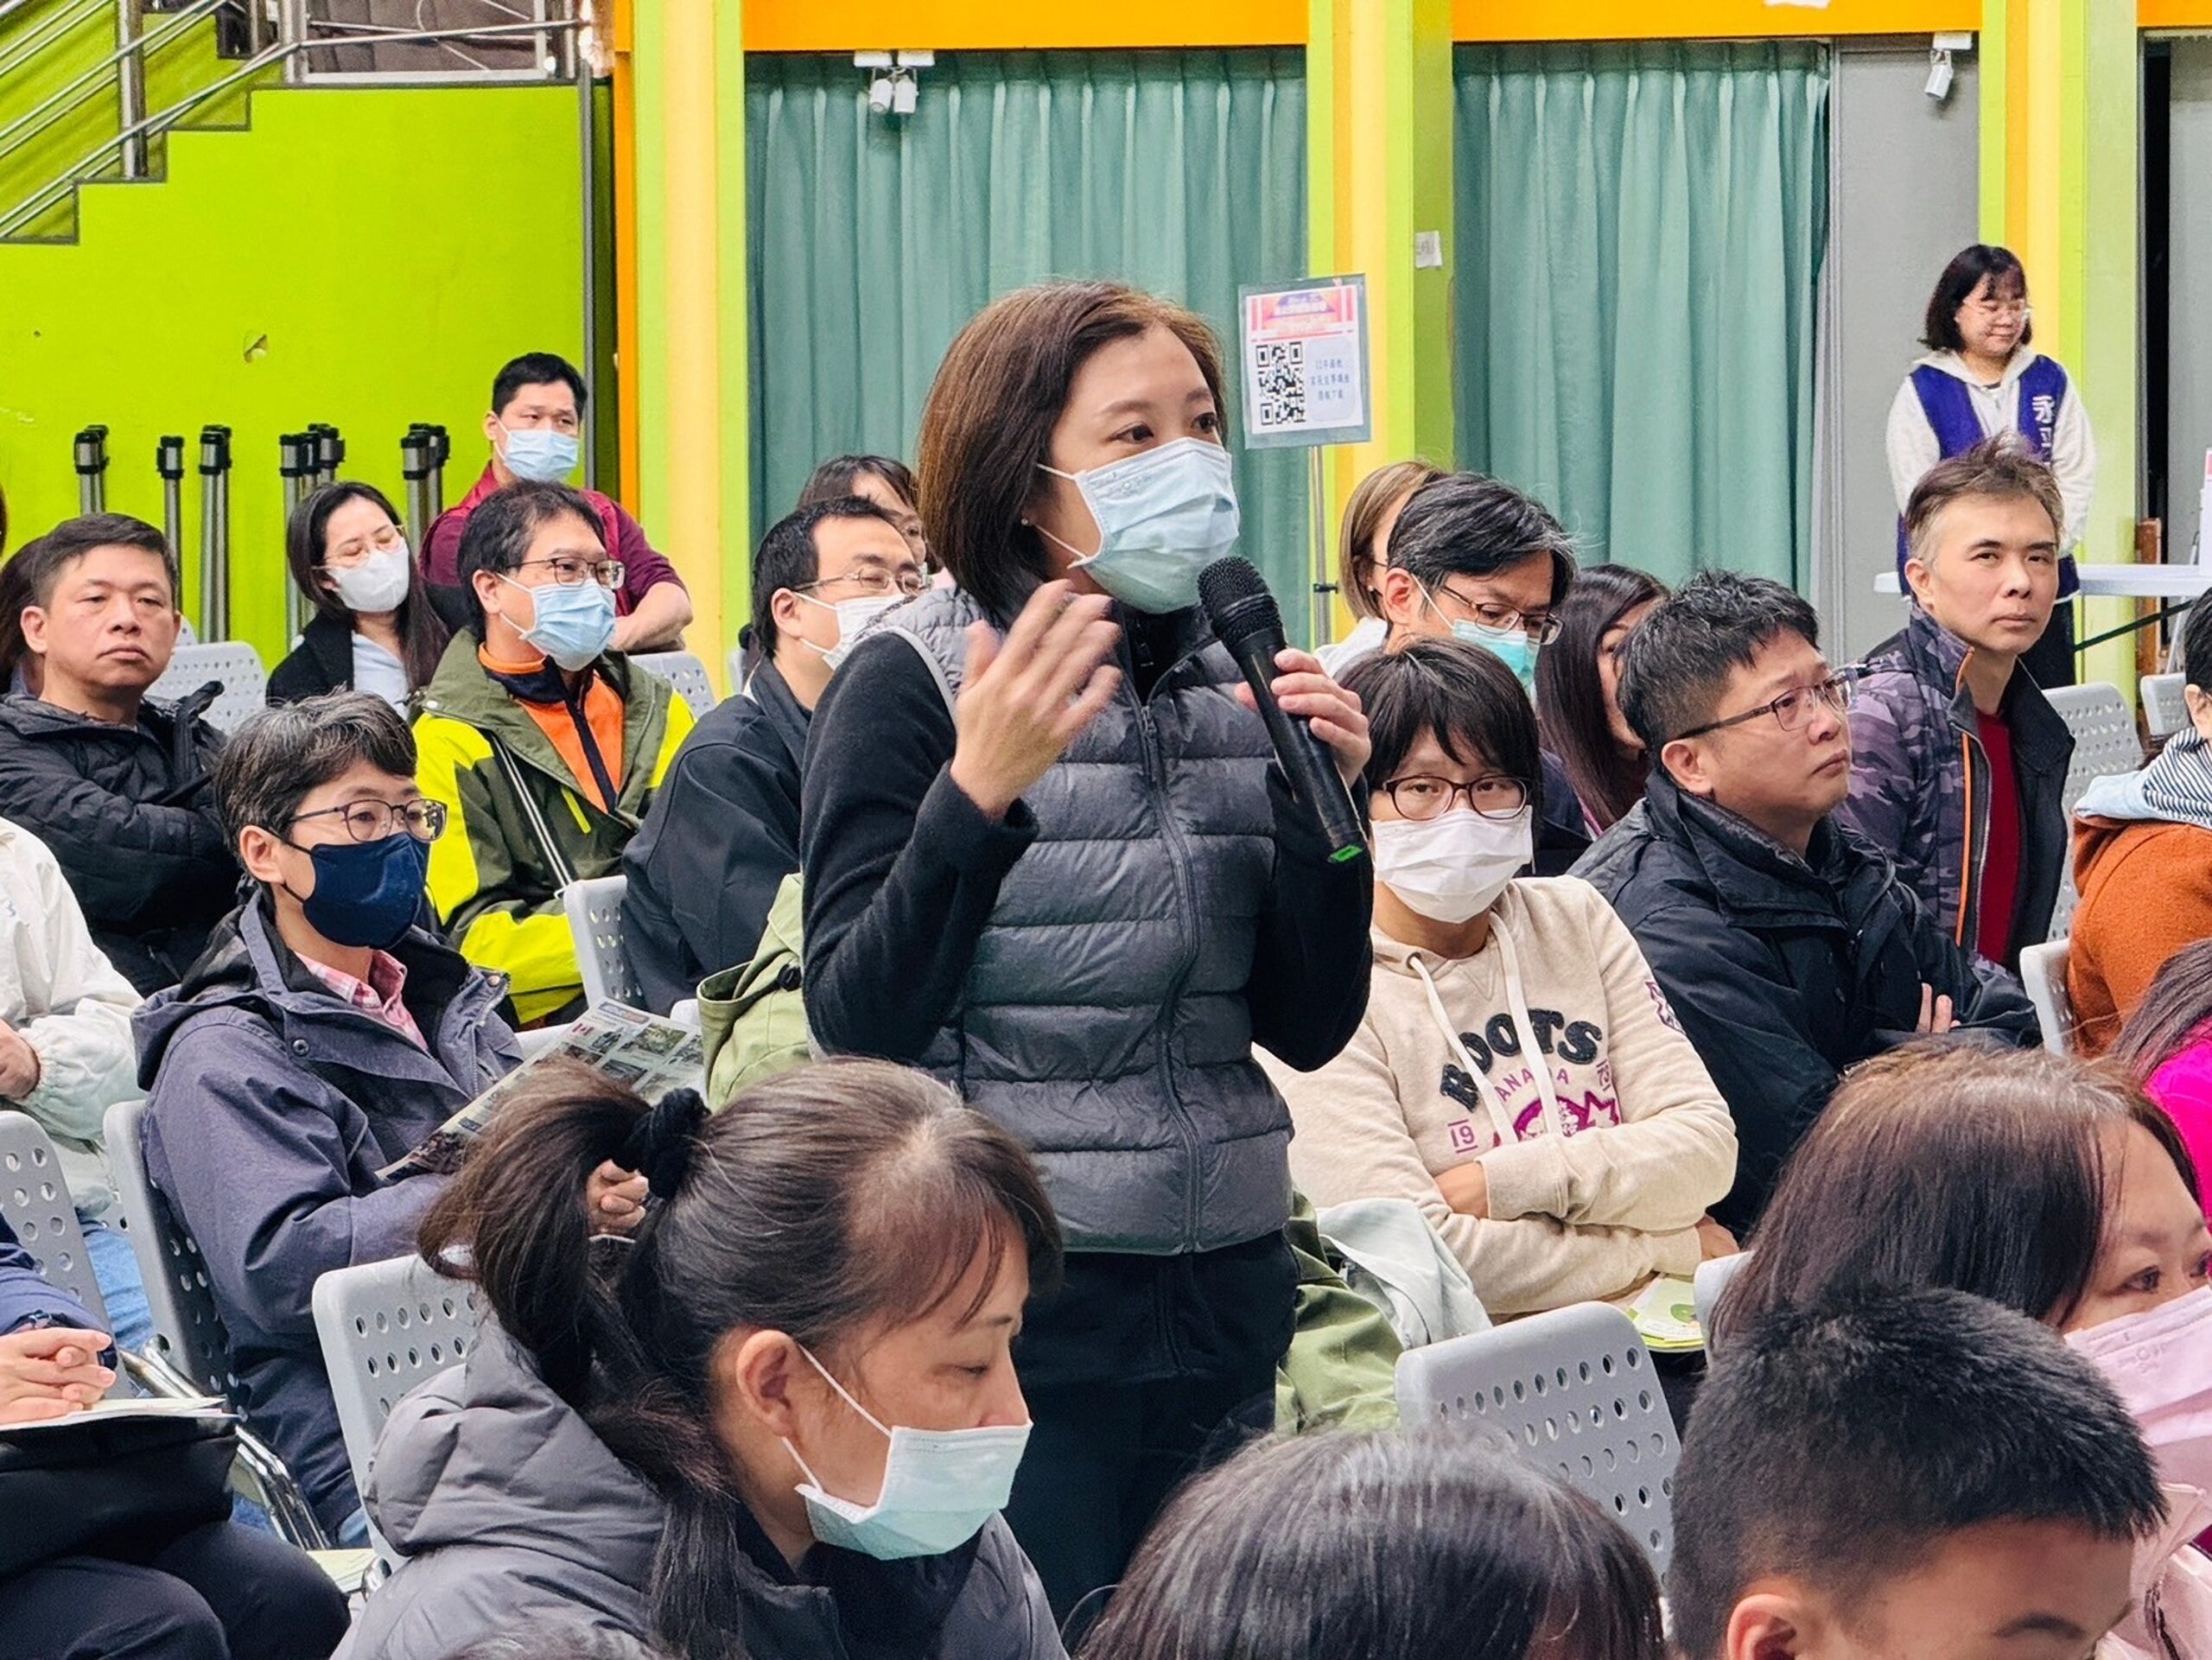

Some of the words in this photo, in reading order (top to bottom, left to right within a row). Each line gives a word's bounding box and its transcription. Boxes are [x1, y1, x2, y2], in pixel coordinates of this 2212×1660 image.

[1440, 1008, 1603, 1113] ROOTS
[1494, 1065, 1569, 1103] ANAA
[1448, 1124, 1476, 1148] 19
